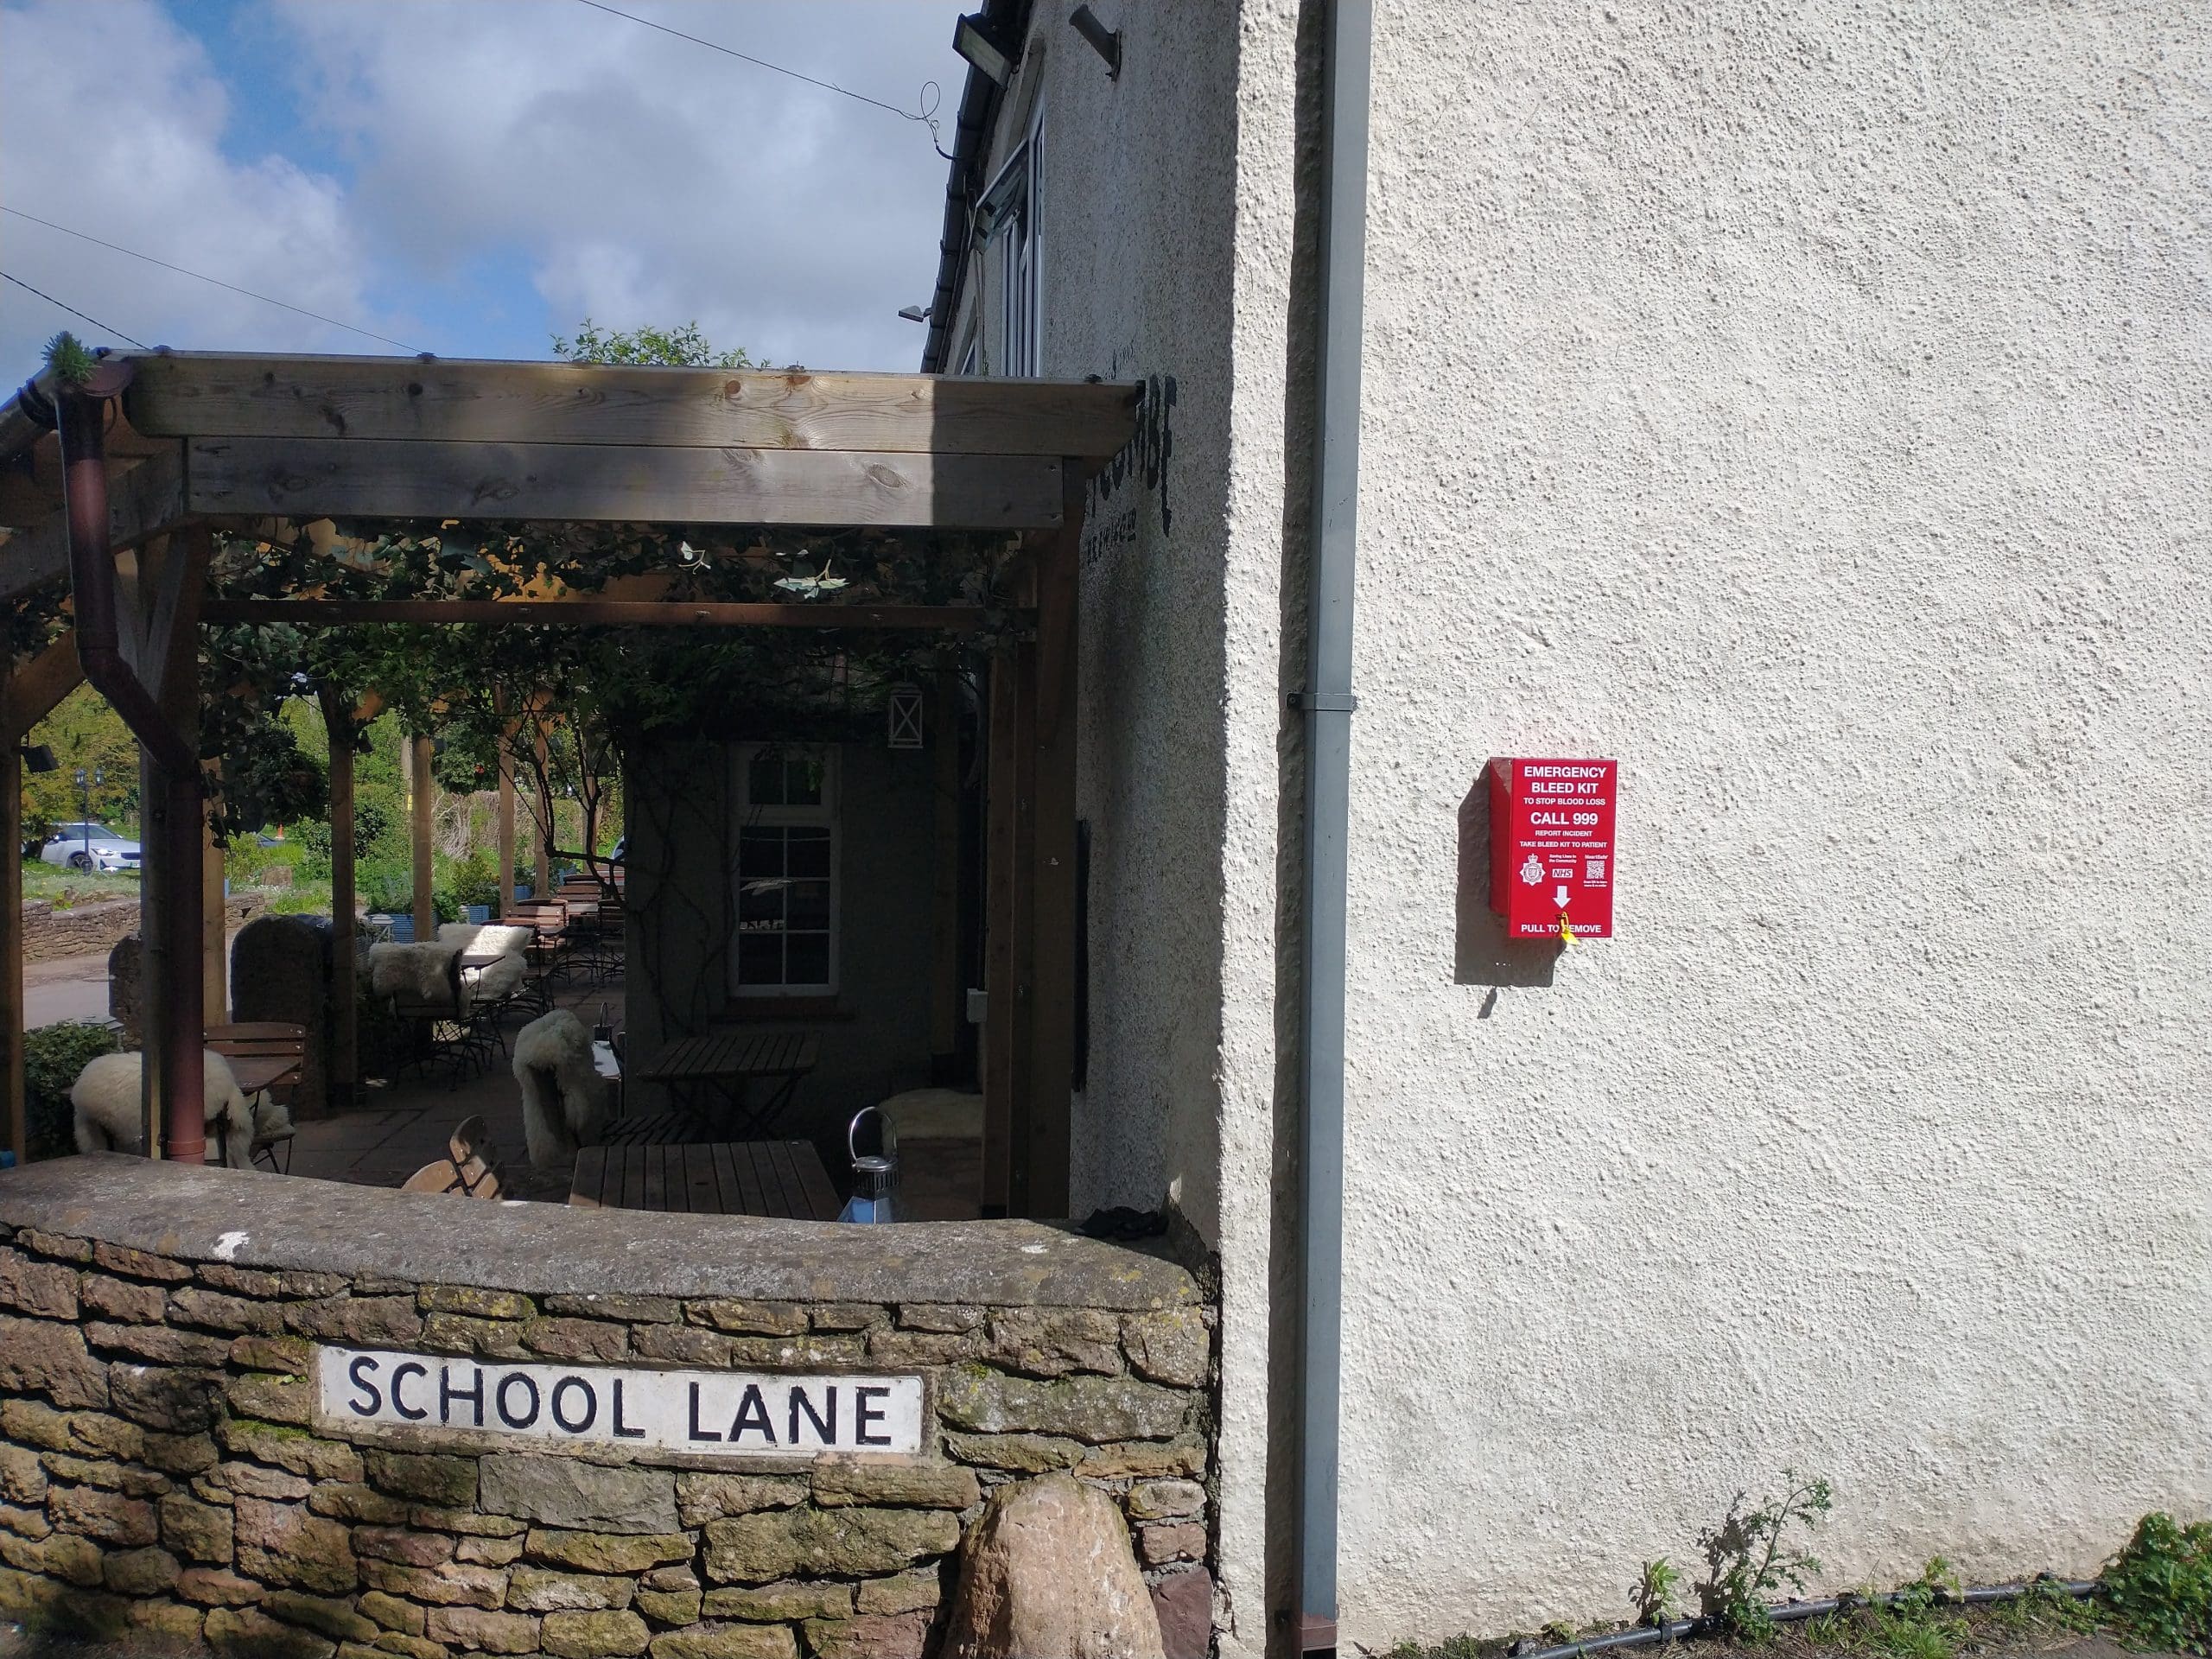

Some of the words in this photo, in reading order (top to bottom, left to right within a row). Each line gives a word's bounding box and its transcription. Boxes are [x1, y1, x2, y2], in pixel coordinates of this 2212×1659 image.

[1524, 766, 1607, 778] EMERGENCY
[1531, 782, 1574, 793] BLEED
[1577, 782, 1599, 793] KIT
[1530, 811, 1570, 825] CALL
[1573, 812, 1599, 825] 999
[1521, 924, 1545, 932] PULL
[1562, 925, 1601, 933] EMOVE
[347, 1356, 646, 1438] SCHOOL
[689, 1381, 893, 1446] LANE
